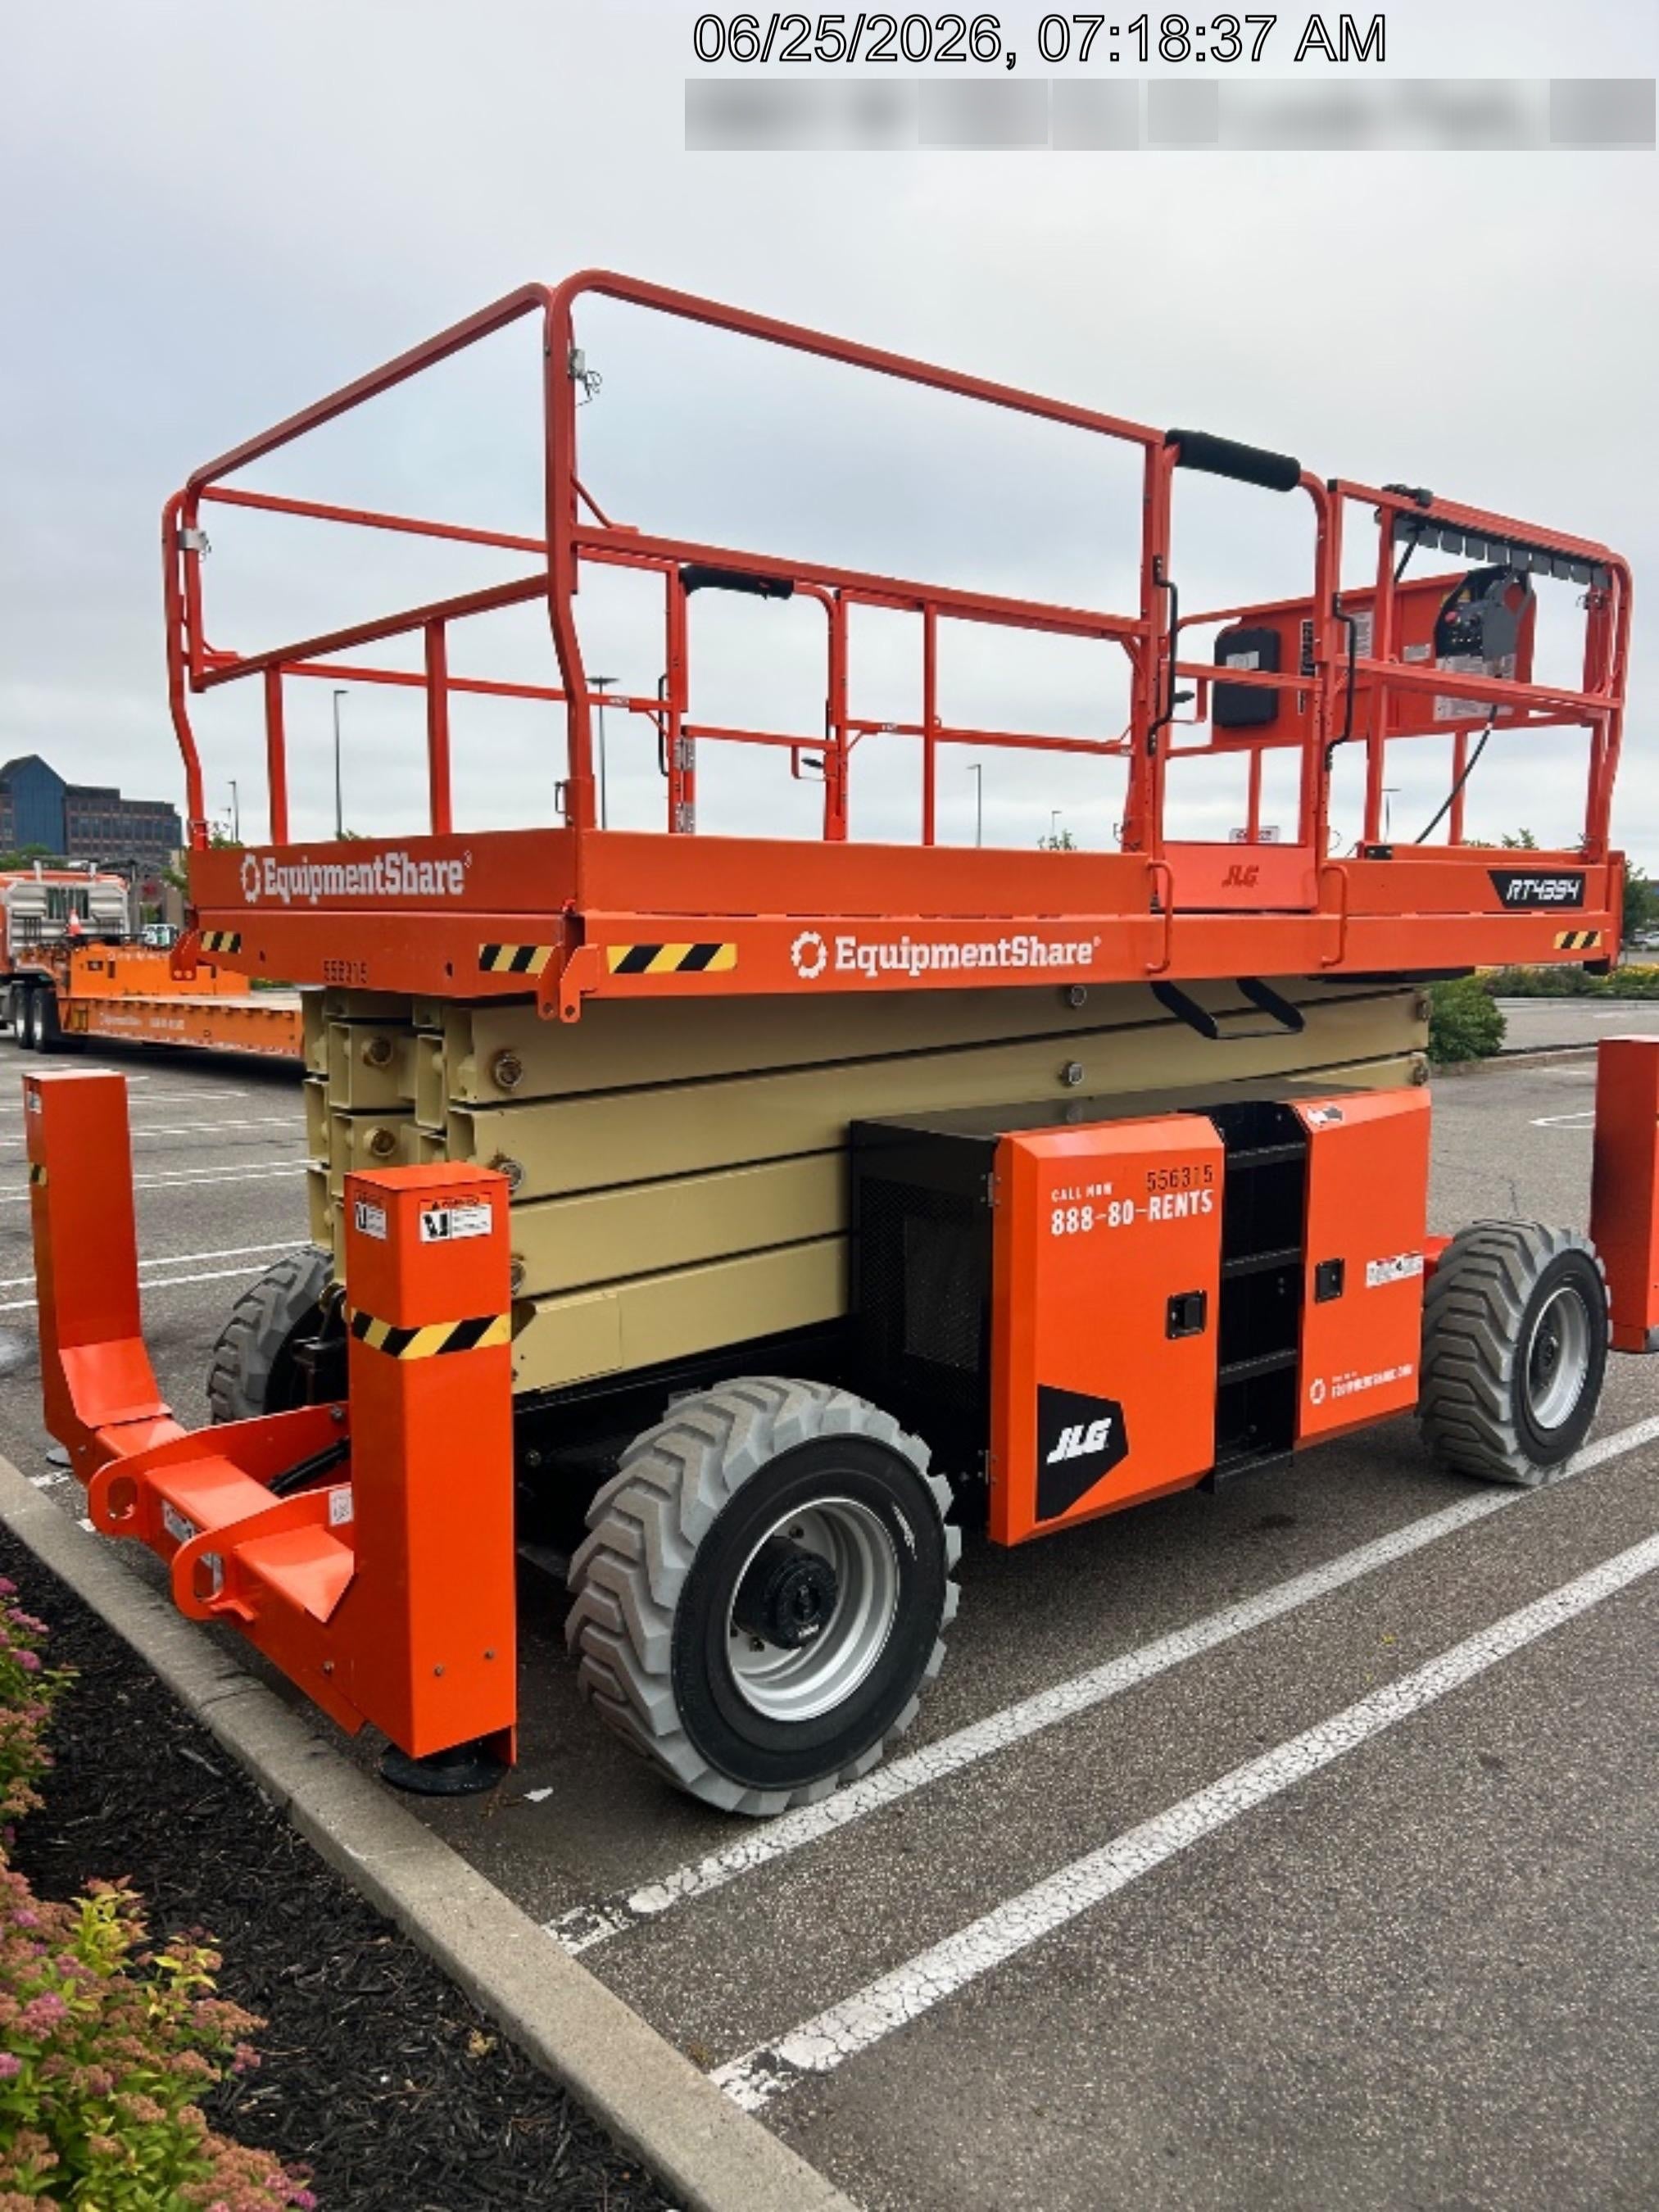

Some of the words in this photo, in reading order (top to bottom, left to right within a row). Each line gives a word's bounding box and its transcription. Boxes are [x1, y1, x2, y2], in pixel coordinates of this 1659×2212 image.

[1221, 864, 1259, 888] JLG
[1051, 1186, 1082, 1203] CALL
[1086, 1181, 1113, 1198] NOW
[1146, 1164, 1213, 1192] 556315
[1050, 1188, 1214, 1237] 888-80-RENTS
[1046, 1417, 1113, 1465] JLG
